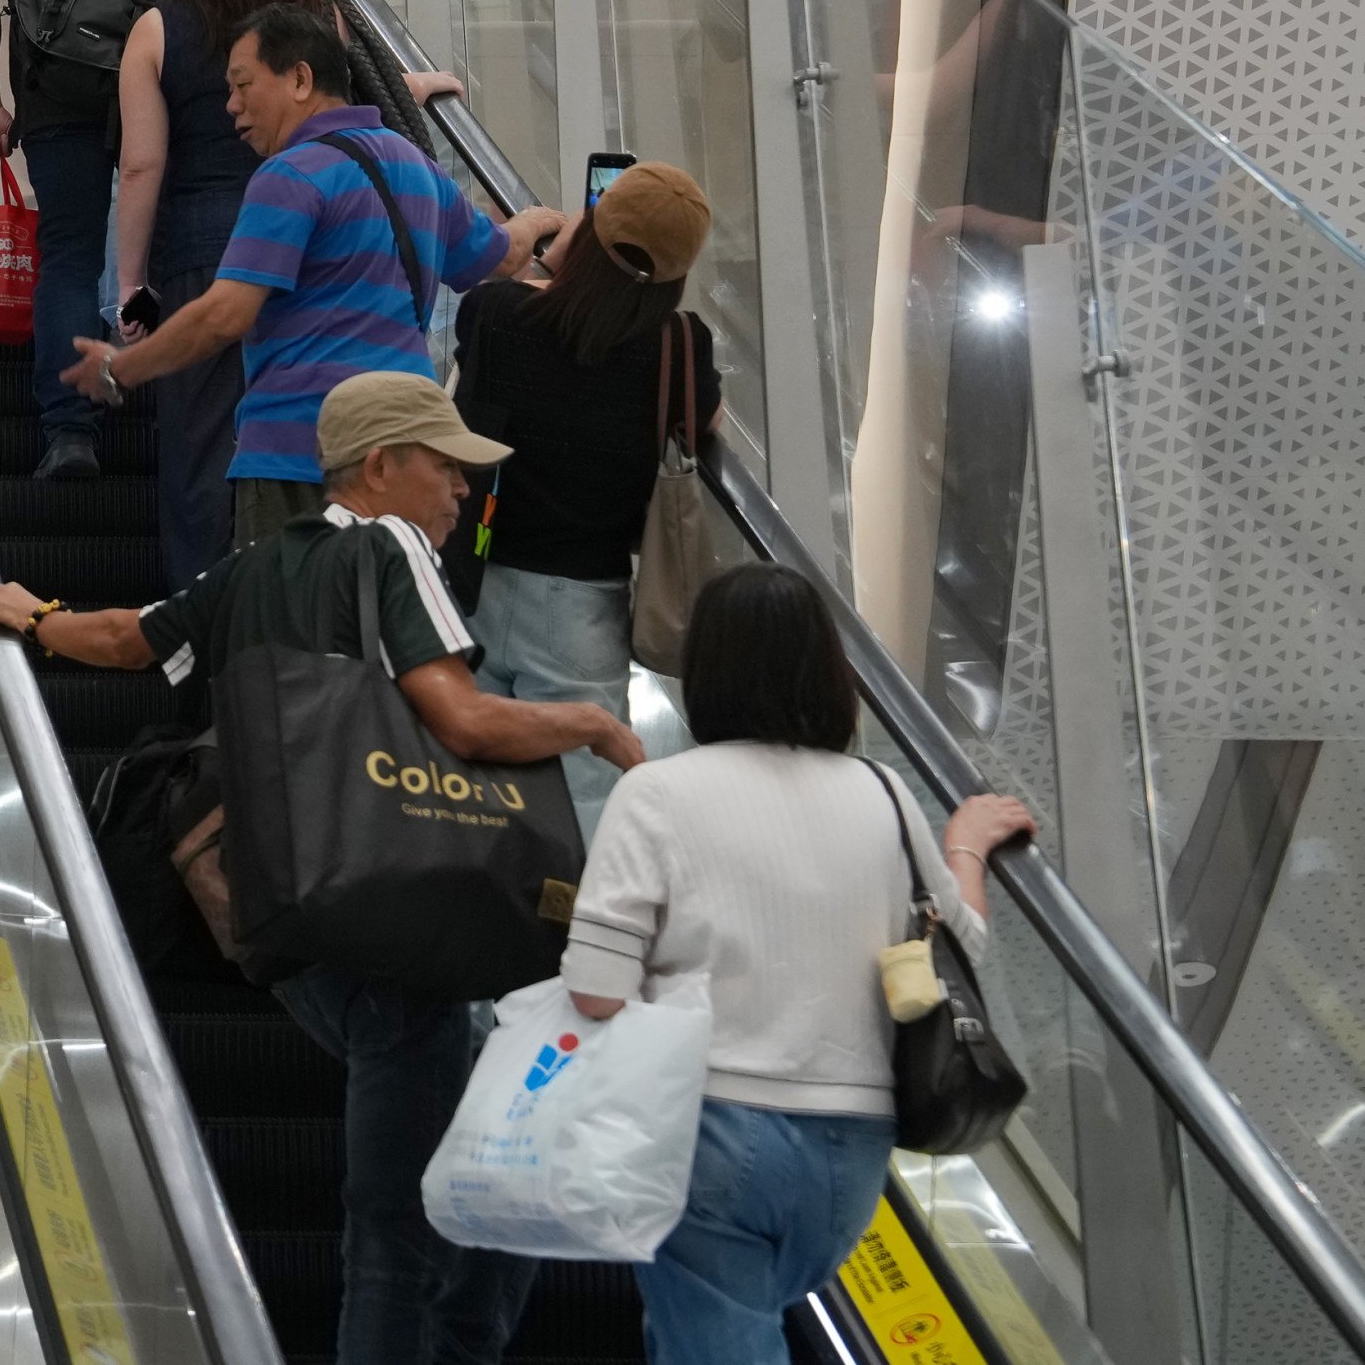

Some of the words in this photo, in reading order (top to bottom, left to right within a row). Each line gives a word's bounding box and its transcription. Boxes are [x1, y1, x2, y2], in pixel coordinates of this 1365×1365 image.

[366, 750, 483, 801] Color
[491, 782, 525, 811] U
[401, 803, 432, 818] Give
[457, 812, 478, 825] the
[481, 814, 509, 827] best
